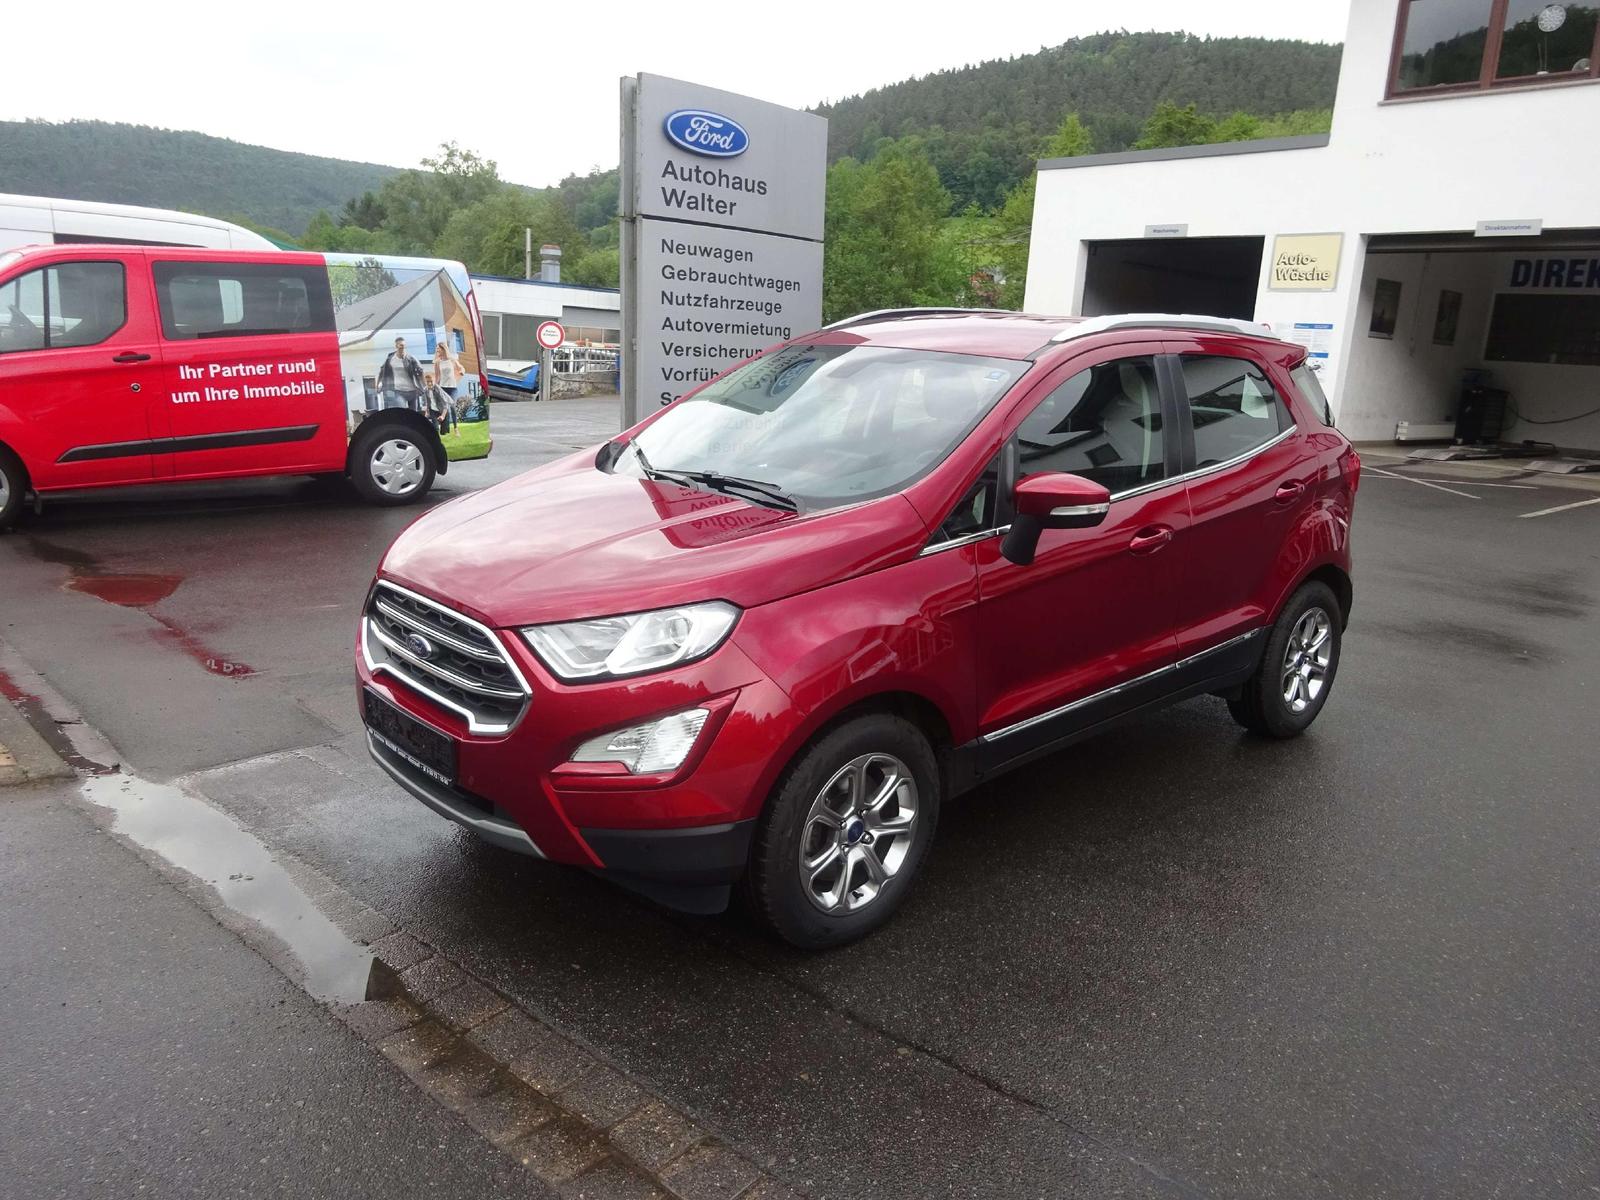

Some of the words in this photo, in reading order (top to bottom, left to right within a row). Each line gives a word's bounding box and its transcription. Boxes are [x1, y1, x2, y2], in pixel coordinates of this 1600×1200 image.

[684, 116, 735, 150] Ford
[661, 160, 768, 195] Autohaus
[661, 187, 737, 216] Walter
[661, 239, 753, 263] Neuwagen
[661, 265, 801, 292] Gebrauchtwagen
[1276, 266, 1330, 281] Wäsche
[661, 290, 782, 315] Nutzfahrzeuge
[661, 317, 791, 340] Autovermietung
[179, 365, 204, 380] Ihr
[209, 363, 273, 378] Partner
[278, 358, 316, 374] rund
[171, 391, 200, 404] um
[204, 387, 239, 401] Ihre
[243, 380, 325, 399] Immobilie
